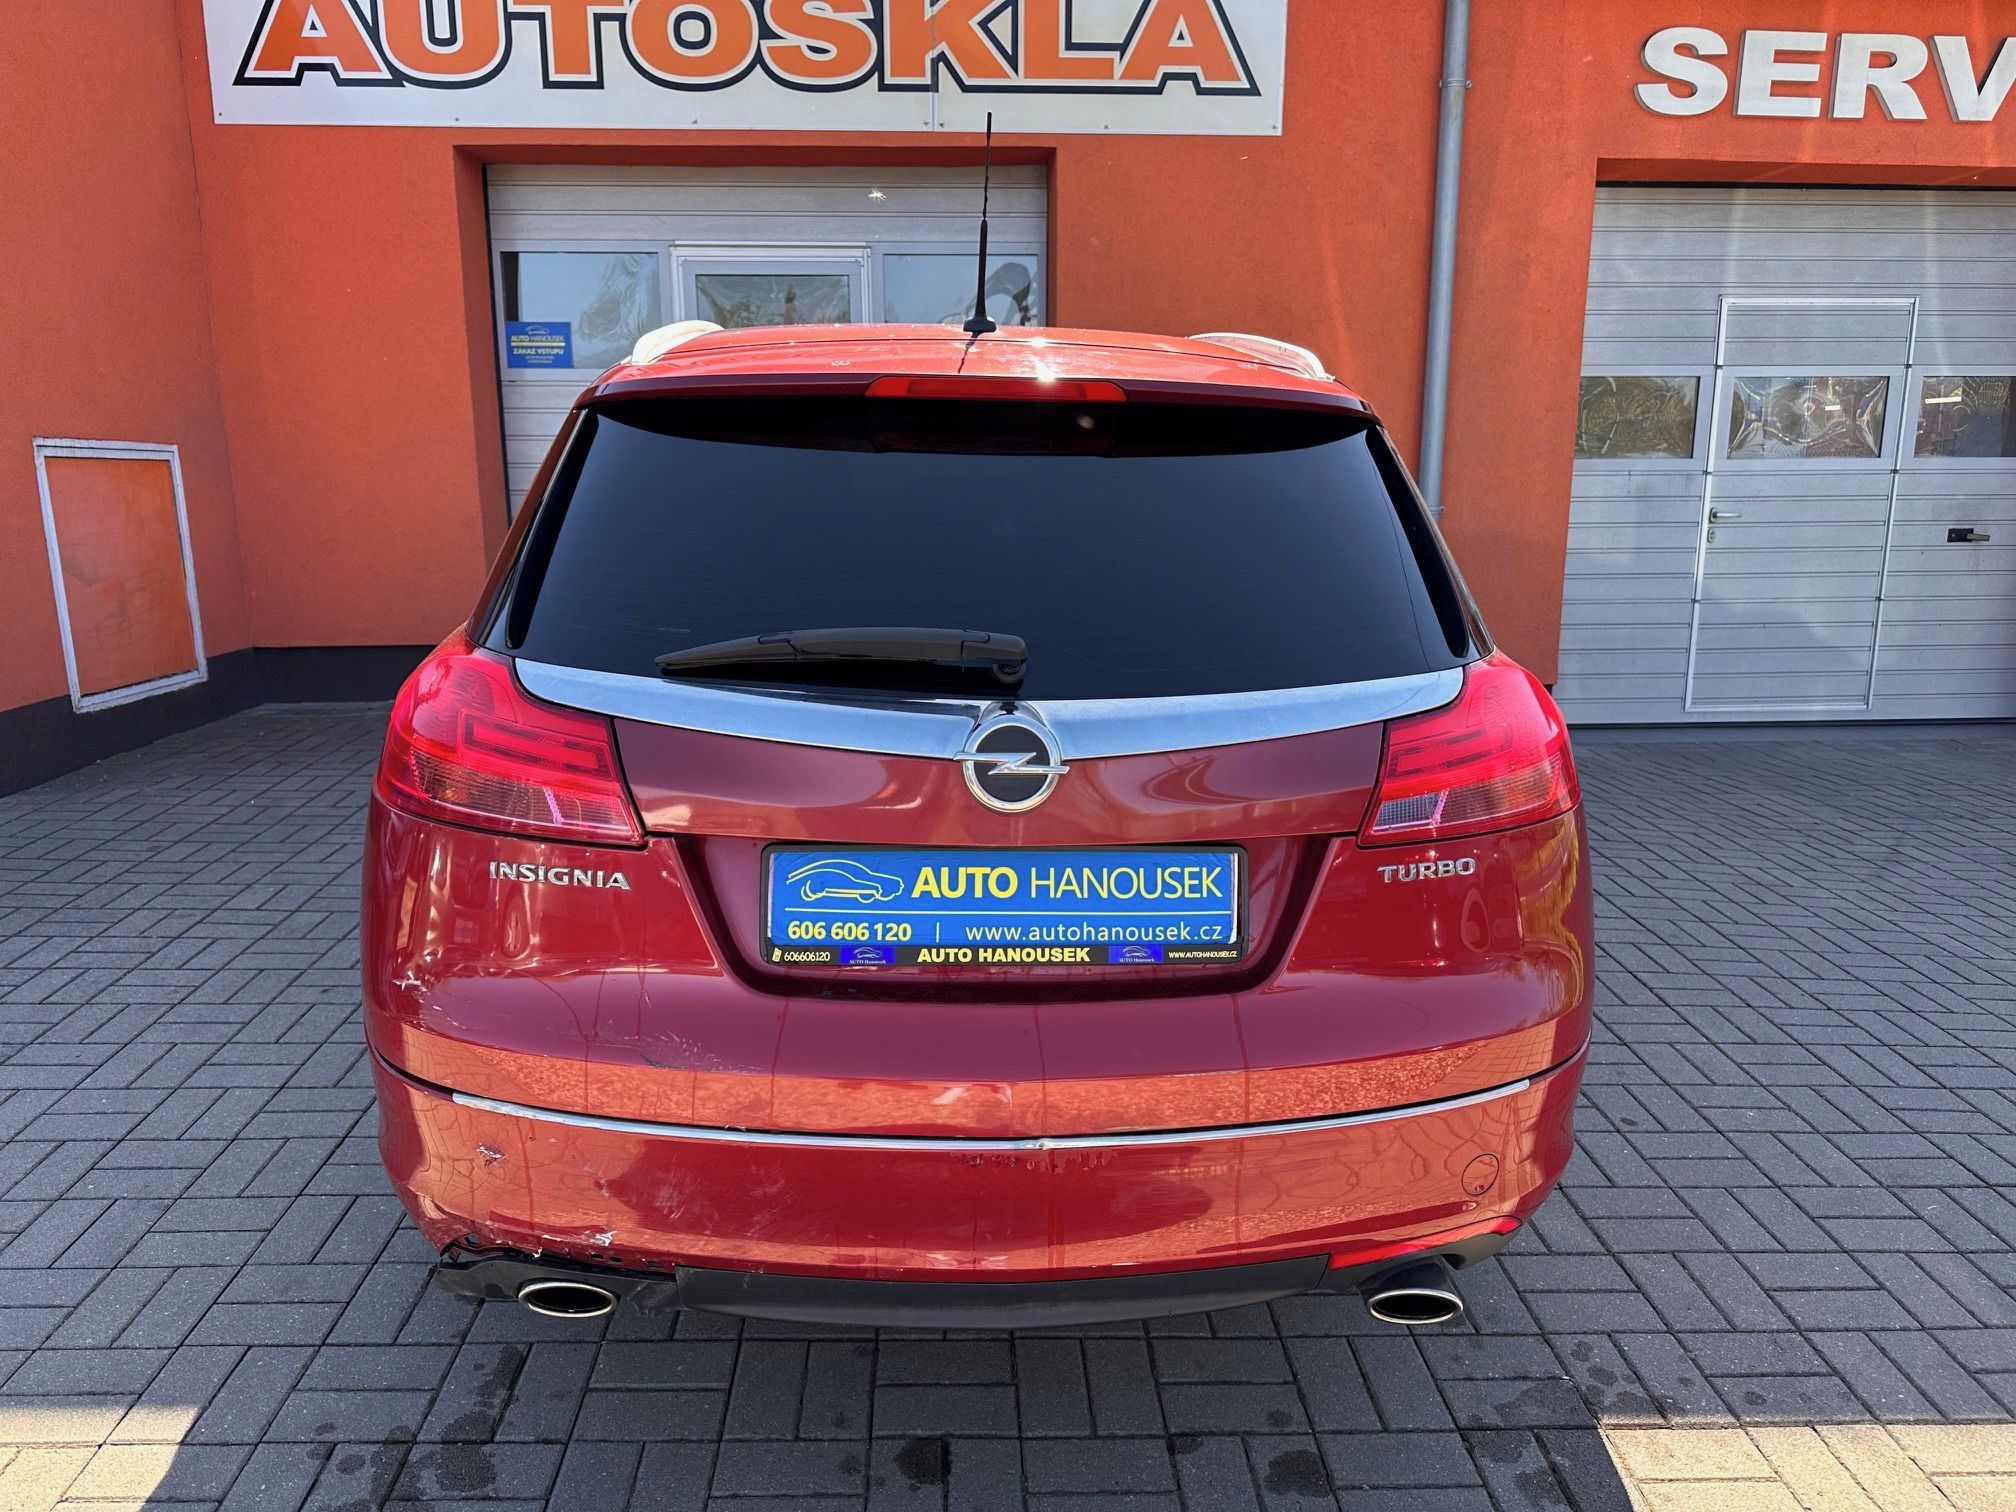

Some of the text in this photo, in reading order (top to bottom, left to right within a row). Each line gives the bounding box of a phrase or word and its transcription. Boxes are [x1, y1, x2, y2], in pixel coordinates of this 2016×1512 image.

[232, 0, 1262, 96] AUTOSKLA
[1633, 26, 2016, 122] SERV
[489, 861, 631, 890] INSIGNIA
[911, 867, 1223, 899] AUTO HANOUSEK
[1377, 857, 1476, 883] TURBO
[788, 921, 1223, 941] 606 606 120 www.autohanousek.cz
[784, 951, 830, 961] 606606120
[917, 948, 1090, 963] AUTO HANOUSEK
